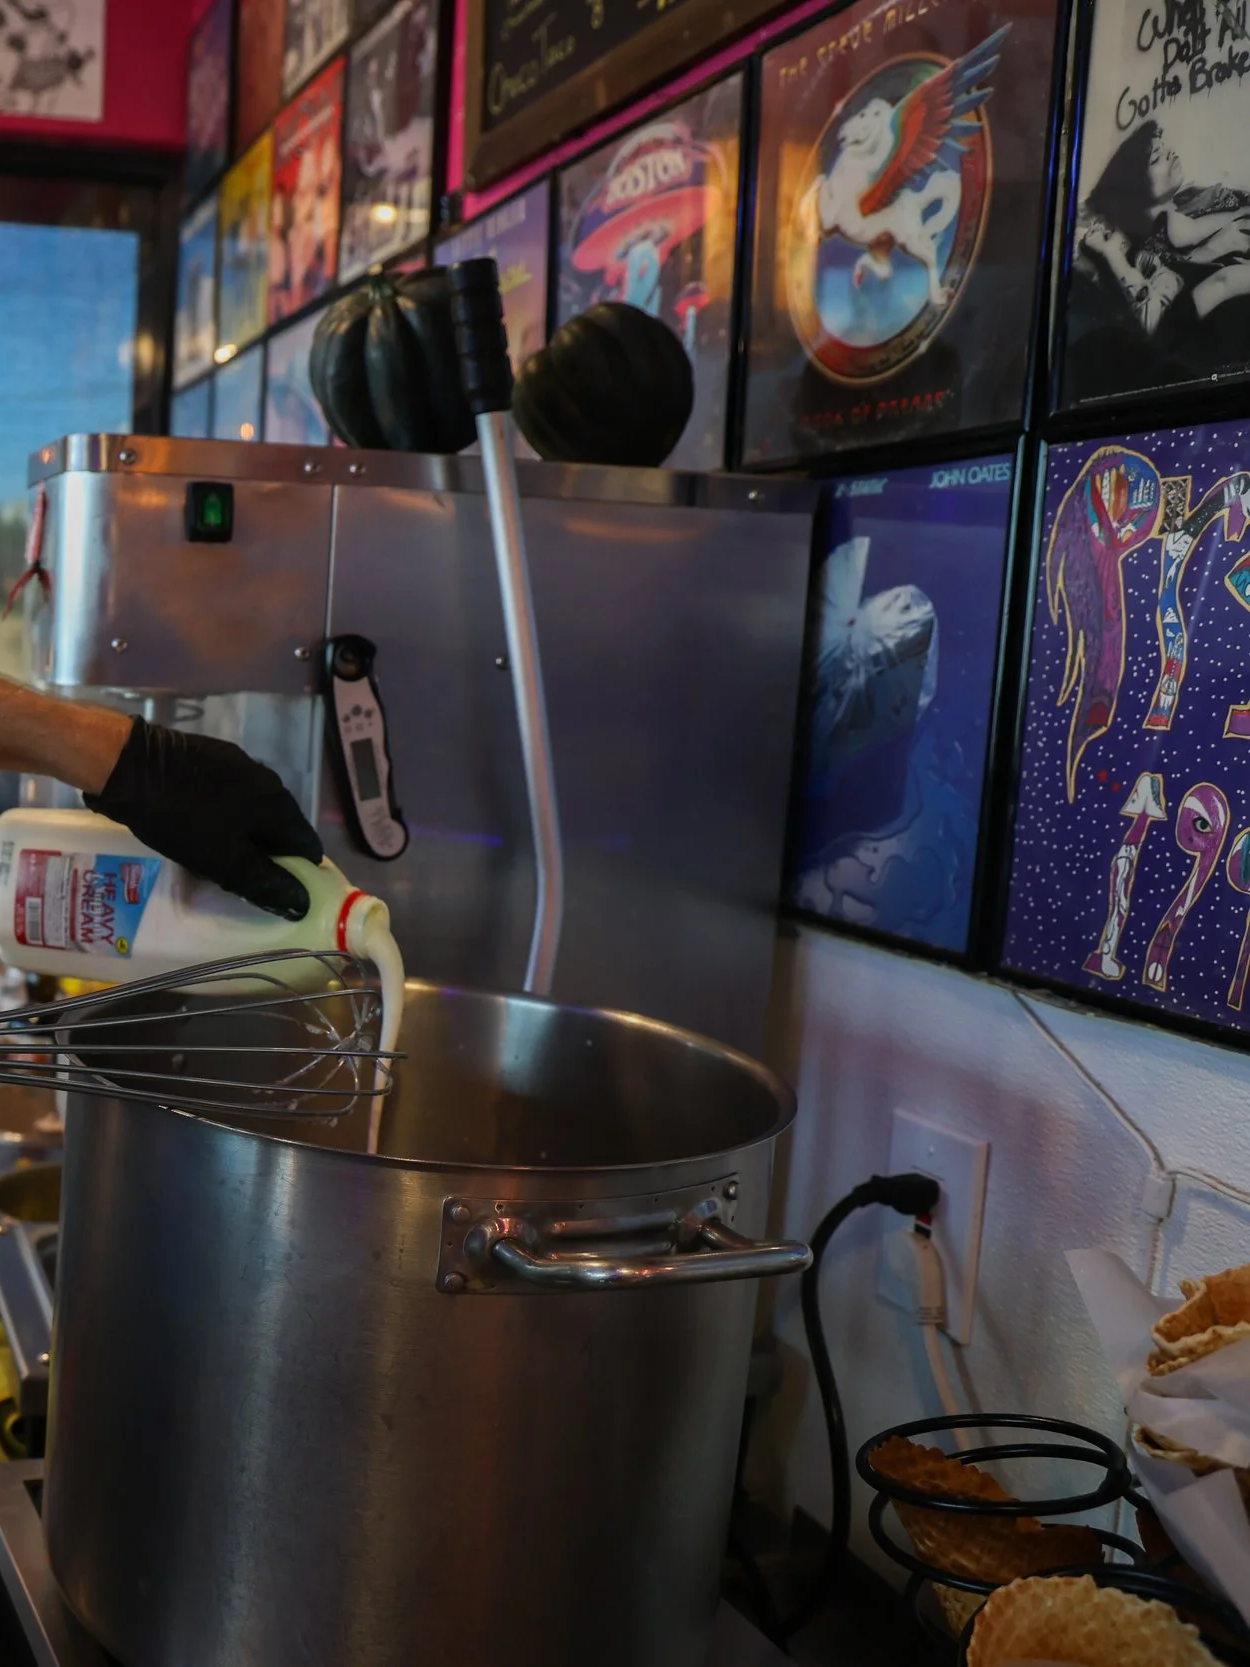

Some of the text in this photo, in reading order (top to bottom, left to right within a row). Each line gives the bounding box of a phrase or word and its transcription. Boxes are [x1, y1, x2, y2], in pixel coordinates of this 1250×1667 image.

[929, 462, 1011, 490] JOHN OATES
[80, 869, 95, 944] CREAM
[102, 871, 118, 947] HEAVY
